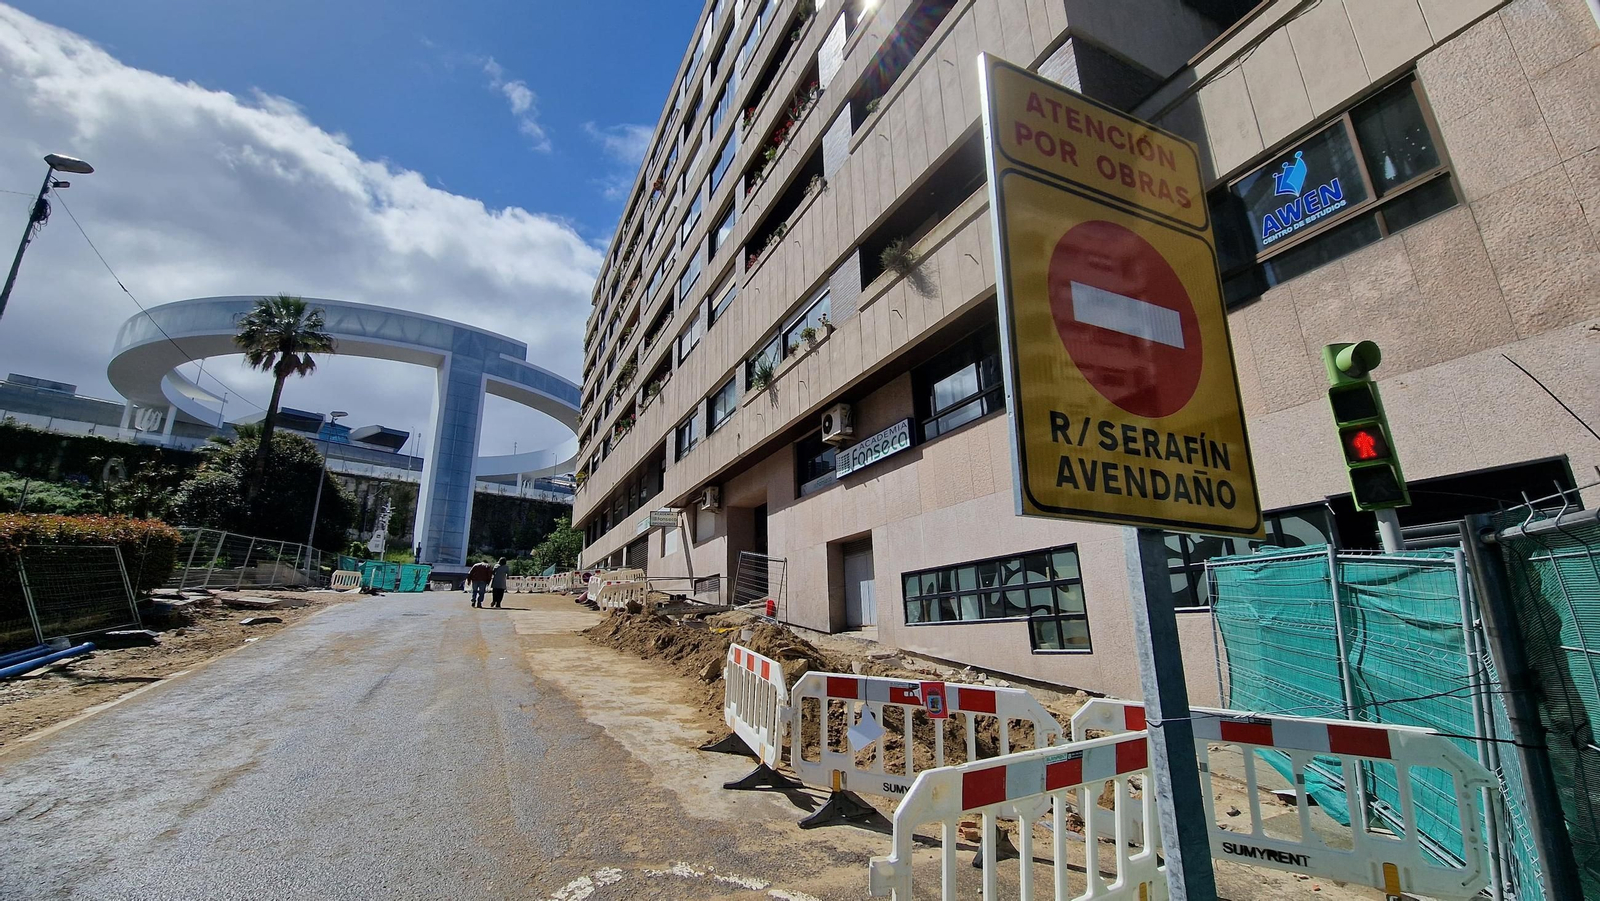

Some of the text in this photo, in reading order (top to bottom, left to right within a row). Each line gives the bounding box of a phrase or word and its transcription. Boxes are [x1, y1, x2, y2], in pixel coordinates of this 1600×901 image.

[1026, 91, 1177, 172] ATENCIÓN
[1014, 120, 1192, 209] POR OBRAS
[1262, 177, 1344, 239] AWEN
[1262, 199, 1347, 246] CENTRO DE ESTUDIOS
[859, 421, 908, 451] ACADEMIA
[1056, 455, 1236, 510] AVENDAÑO
[882, 782, 911, 794] SUMY
[1222, 841, 1311, 867] SUMYRENT
